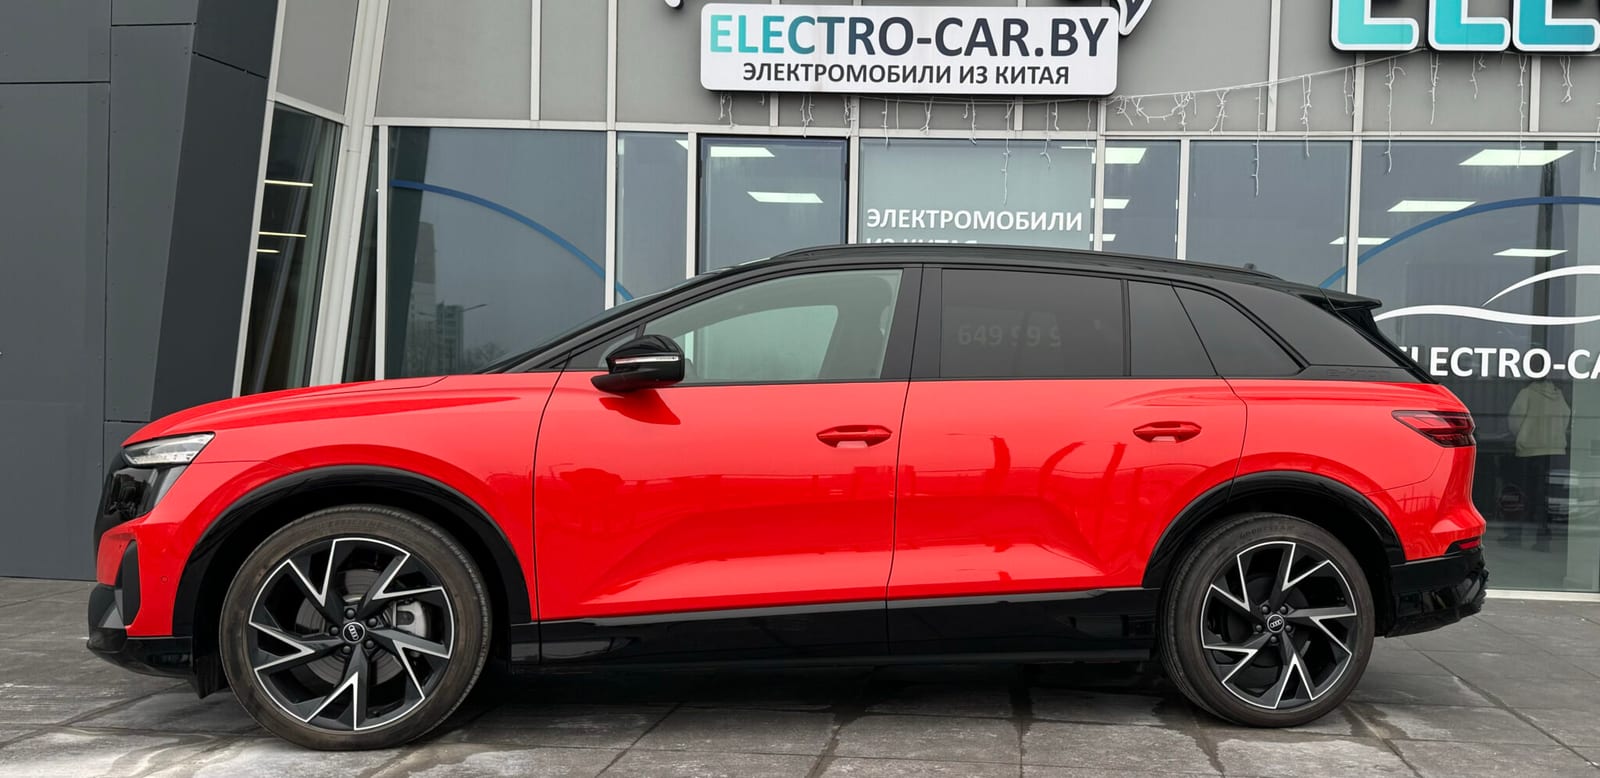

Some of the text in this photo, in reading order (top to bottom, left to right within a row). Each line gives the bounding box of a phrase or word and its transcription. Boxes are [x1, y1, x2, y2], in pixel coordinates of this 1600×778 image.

[709, 14, 1109, 57] ELECTRO-CAR.BY
[743, 63, 1069, 85] ЭЛЕКТРОМОБИЛИ ИЗ КИТАЯ
[866, 208, 1082, 231] ЭЛЕКТРОМОБИЛИ
[1400, 346, 1600, 379] ECTRO-C
